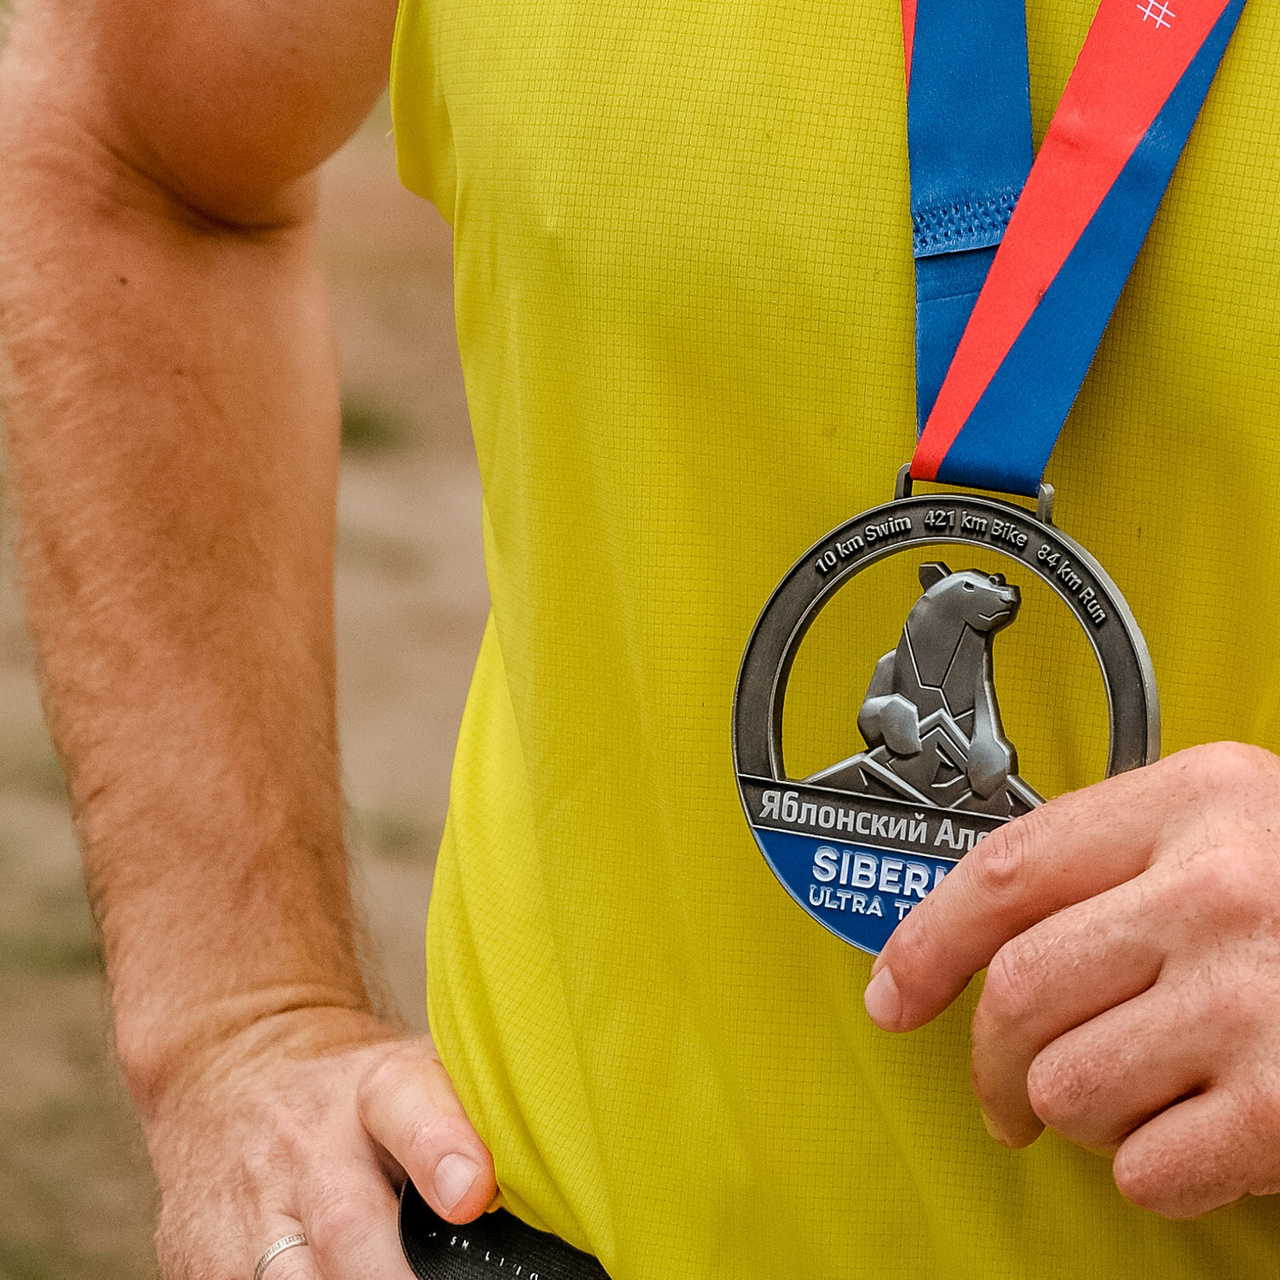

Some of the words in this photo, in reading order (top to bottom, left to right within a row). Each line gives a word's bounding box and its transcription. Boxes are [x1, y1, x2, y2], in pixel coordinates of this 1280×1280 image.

[815, 549, 837, 573] 10
[836, 535, 864, 558] km
[865, 515, 912, 542] Swim
[924, 509, 956, 528] 421
[960, 511, 988, 532] km
[990, 518, 1029, 547] Bike
[1036, 544, 1058, 568] 84
[1056, 559, 1084, 592] km
[1078, 586, 1107, 625] Run
[758, 789, 928, 845] Яблонский
[808, 884, 884, 918] ULTRA
